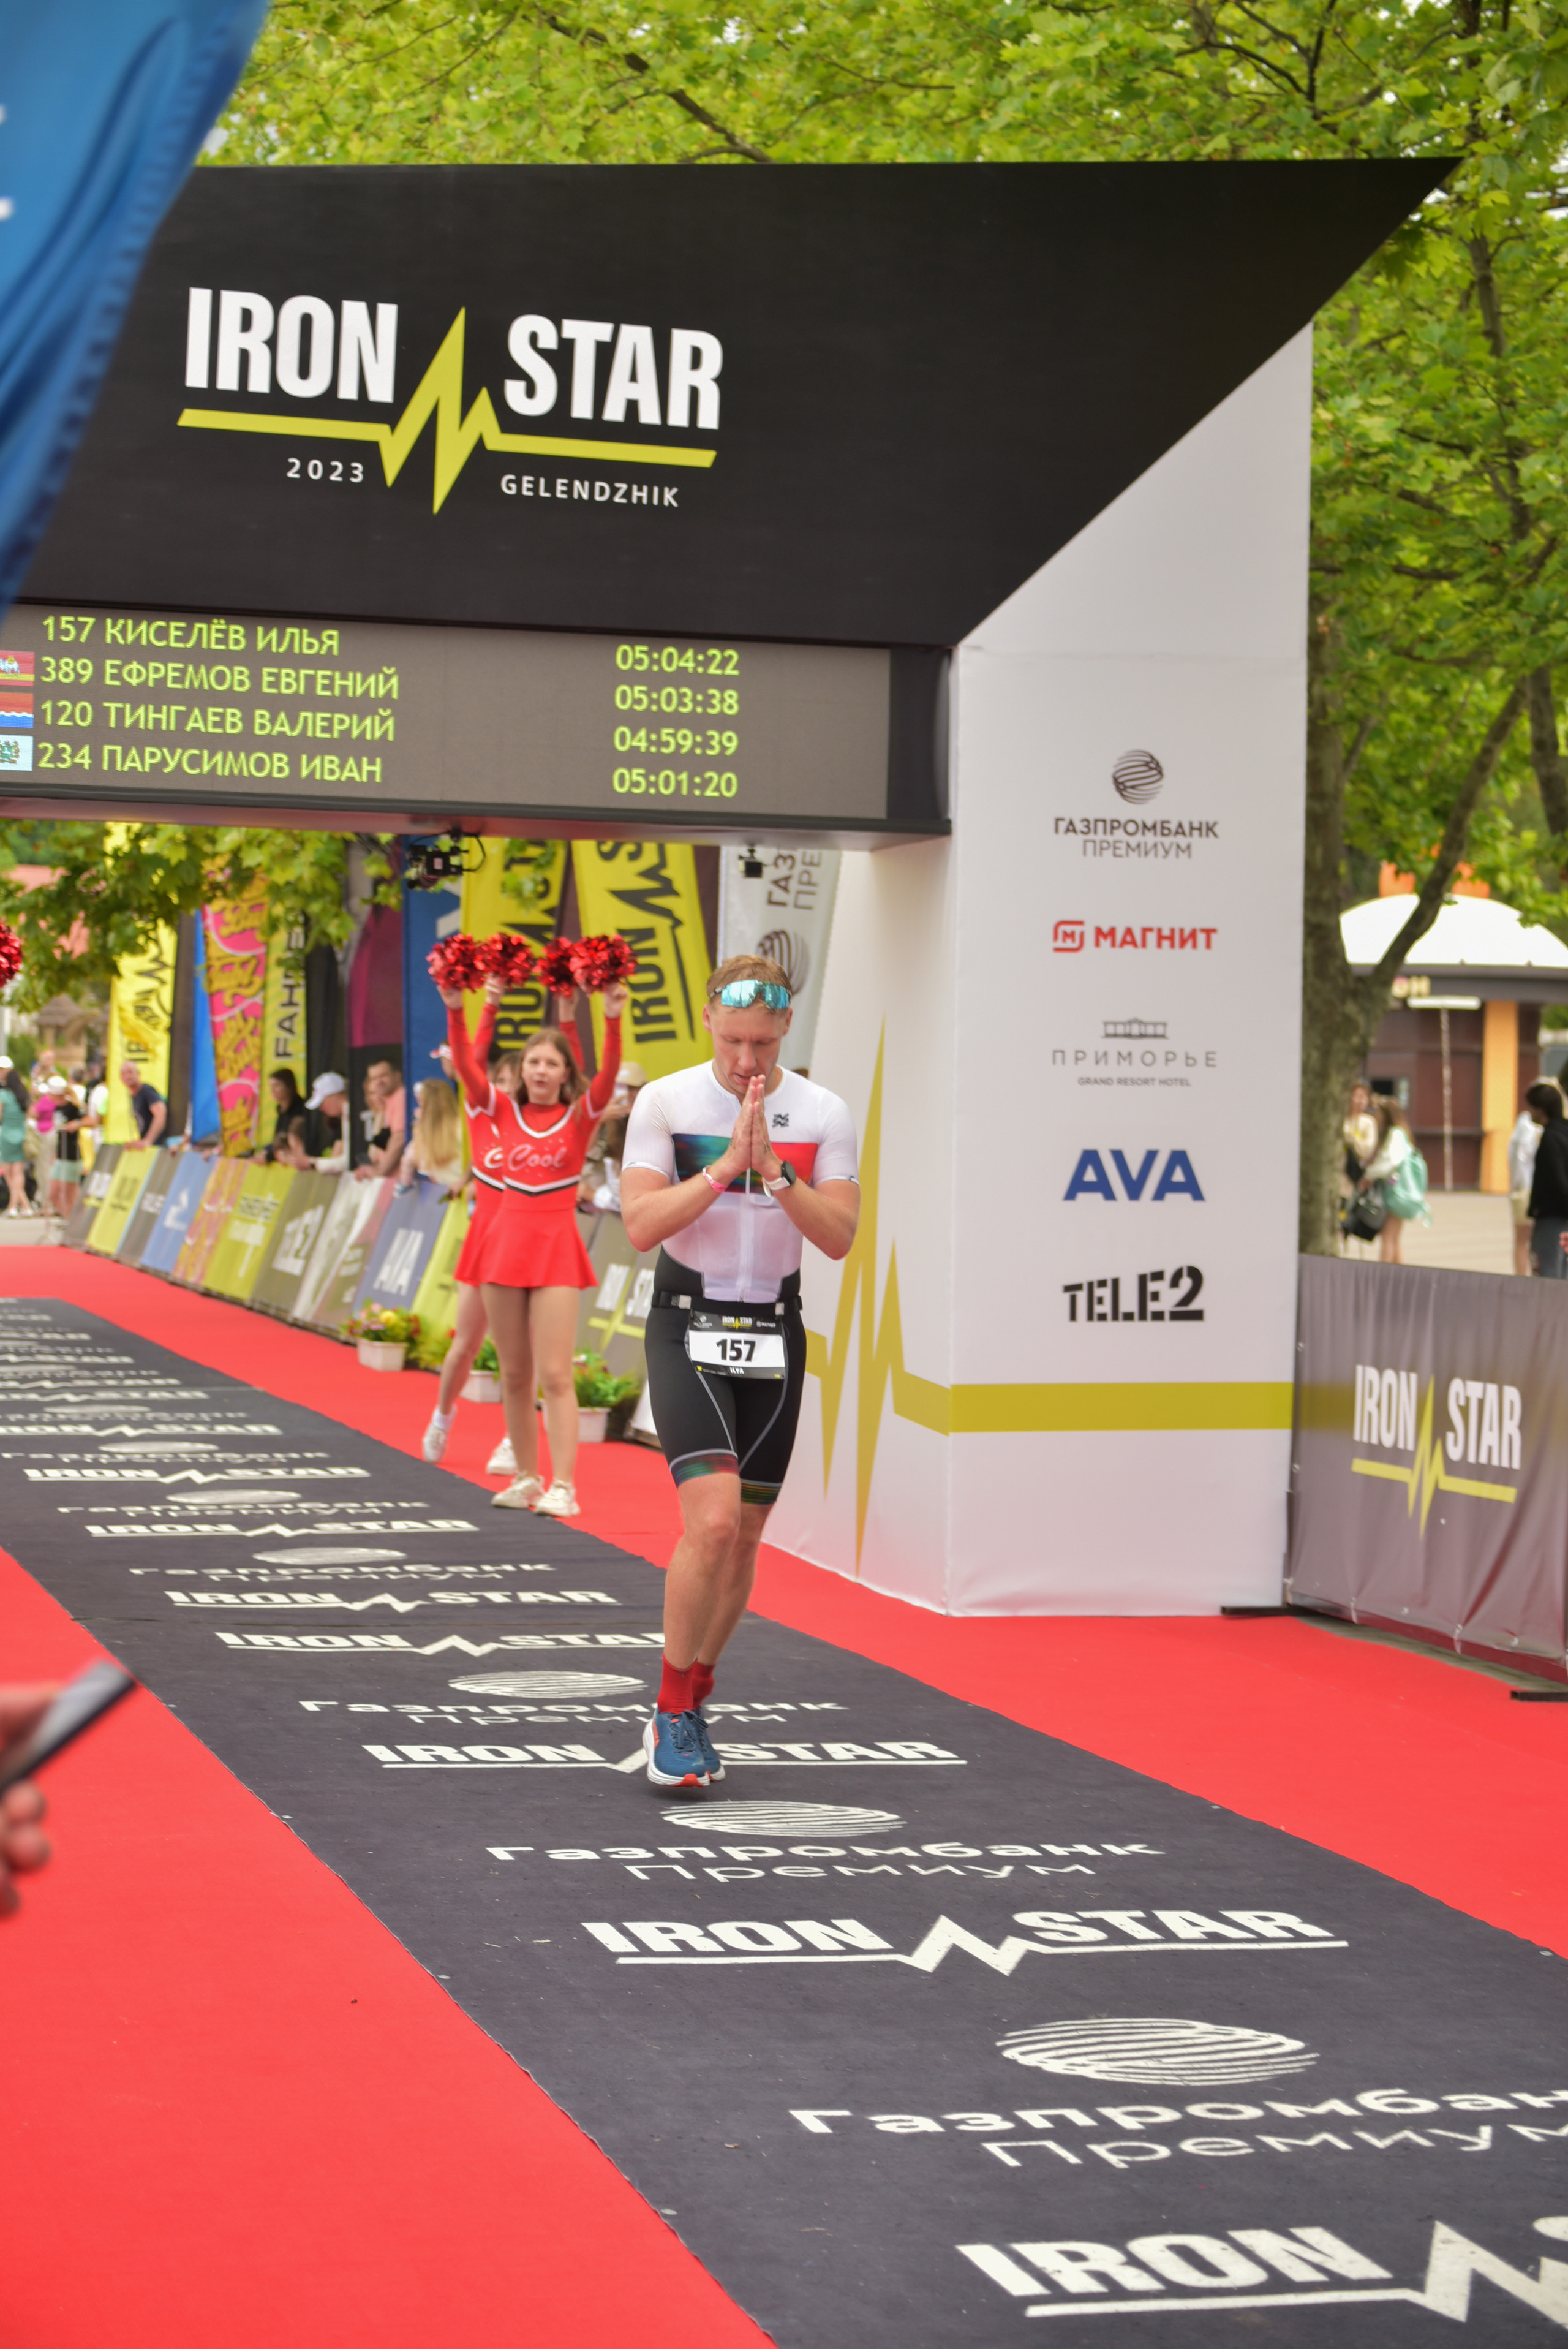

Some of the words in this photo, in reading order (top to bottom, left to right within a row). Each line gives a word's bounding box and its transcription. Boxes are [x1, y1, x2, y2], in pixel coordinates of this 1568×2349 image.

[184, 287, 399, 404] IRON
[503, 314, 724, 431] STAR
[285, 457, 365, 484] 2023
[500, 474, 679, 509] GELENDZHIK
[42, 615, 96, 643] 157
[105, 619, 246, 652] КИСЕЛЁВ
[256, 626, 340, 656] ИЛЬЯ
[615, 644, 740, 676] 05:04:22
[40, 656, 94, 684] 389
[104, 659, 251, 692] ЕФРЕМОВ
[261, 666, 399, 699] ЕВГЕНИЙ
[614, 684, 739, 716] 05:03:38
[40, 700, 92, 727] 120
[102, 702, 243, 735] ТИНГАЕВ
[254, 709, 395, 741] ВАЛЕРИЙ
[614, 725, 739, 757] 04:59:39
[37, 743, 92, 770] 234
[102, 745, 290, 778] ПАРУСИМОВ
[300, 754, 382, 783] ИВАН
[612, 767, 738, 798] 05:01:20
[1054, 817, 1219, 838] ГАЗПРОМБАНК
[1083, 839, 1192, 858] ПРЕМИУМ
[1094, 926, 1218, 950] МАГНИТ
[1052, 1050, 1218, 1067] ПРИМОРЬЕ
[1078, 1077, 1114, 1086] GRAND
[1117, 1077, 1155, 1086] RESORT
[1159, 1078, 1191, 1087] HOTEL
[507, 1144, 567, 1171] Cool
[1063, 1149, 1205, 1201] AVA
[1063, 1266, 1204, 1322] TELE2
[722, 1315, 735, 1324] IRON
[716, 1338, 756, 1362] 157
[729, 1366, 745, 1375] ILYA
[1353, 1364, 1418, 1450] IRON
[1446, 1378, 1522, 1470] STAR
[224, 1467, 369, 1477] STAR
[85, 1524, 241, 1534] IRON
[312, 1519, 478, 1532] STAR
[165, 1591, 343, 1604] IRON
[428, 1591, 619, 1605] STAR
[214, 1632, 415, 1648] IRON
[298, 1700, 849, 1717] Газпроманк
[405, 1712, 788, 1727] Премм
[361, 1744, 607, 1763] IRON
[710, 1742, 960, 1761] STAR
[485, 1840, 1166, 1861] Газпромбанк
[624, 1864, 1098, 1883] Премиум
[581, 1918, 895, 1953] IRON
[1012, 1910, 1335, 1942] STAR
[956, 2226, 1393, 2296] IRON
